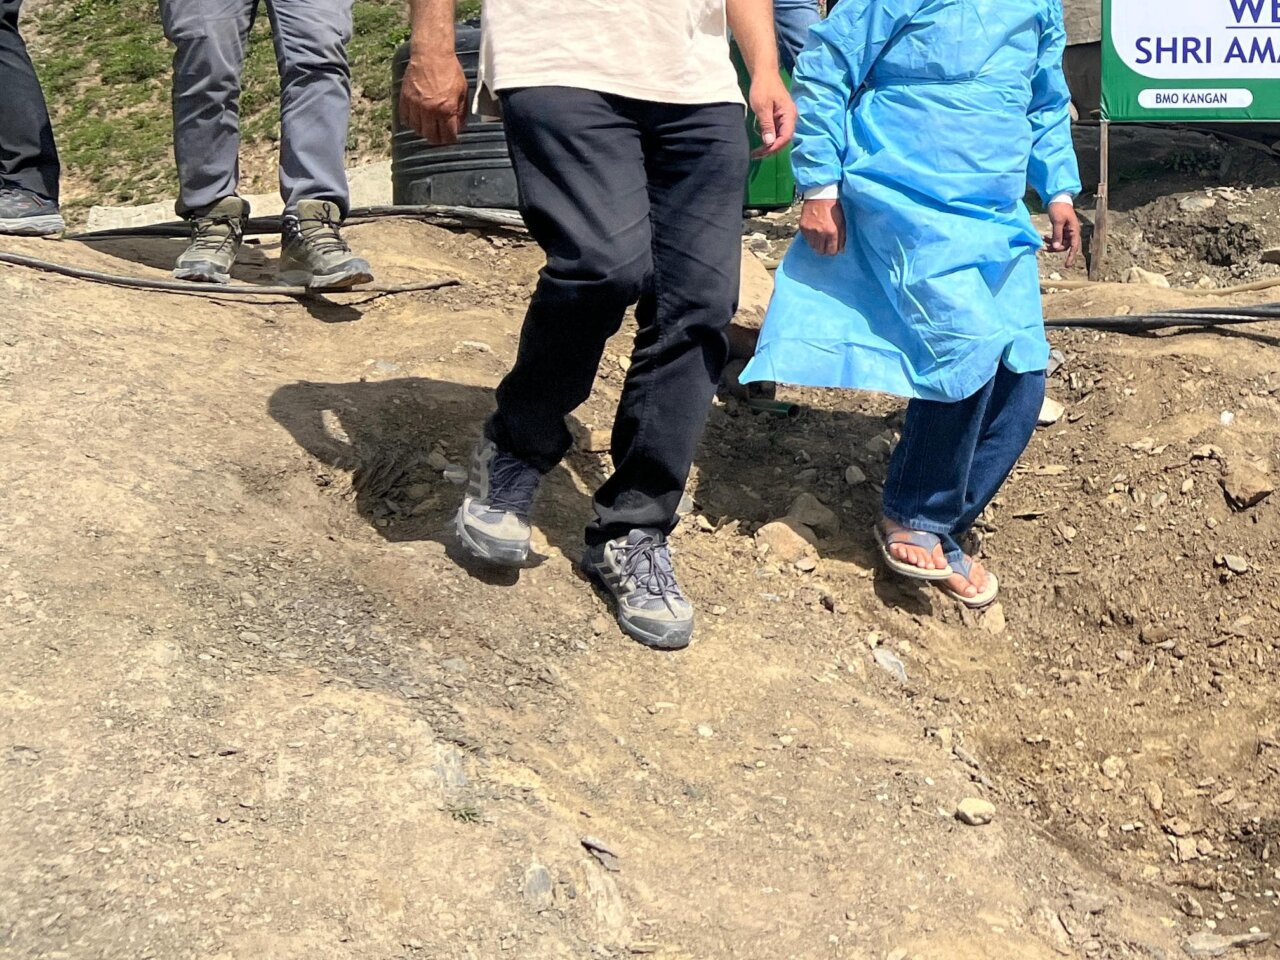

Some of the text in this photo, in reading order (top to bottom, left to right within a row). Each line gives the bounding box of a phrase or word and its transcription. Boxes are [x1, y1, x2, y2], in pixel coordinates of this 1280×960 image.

[1135, 37, 1212, 65] SHRI
[1155, 93, 1228, 104] BMO KANGAN
